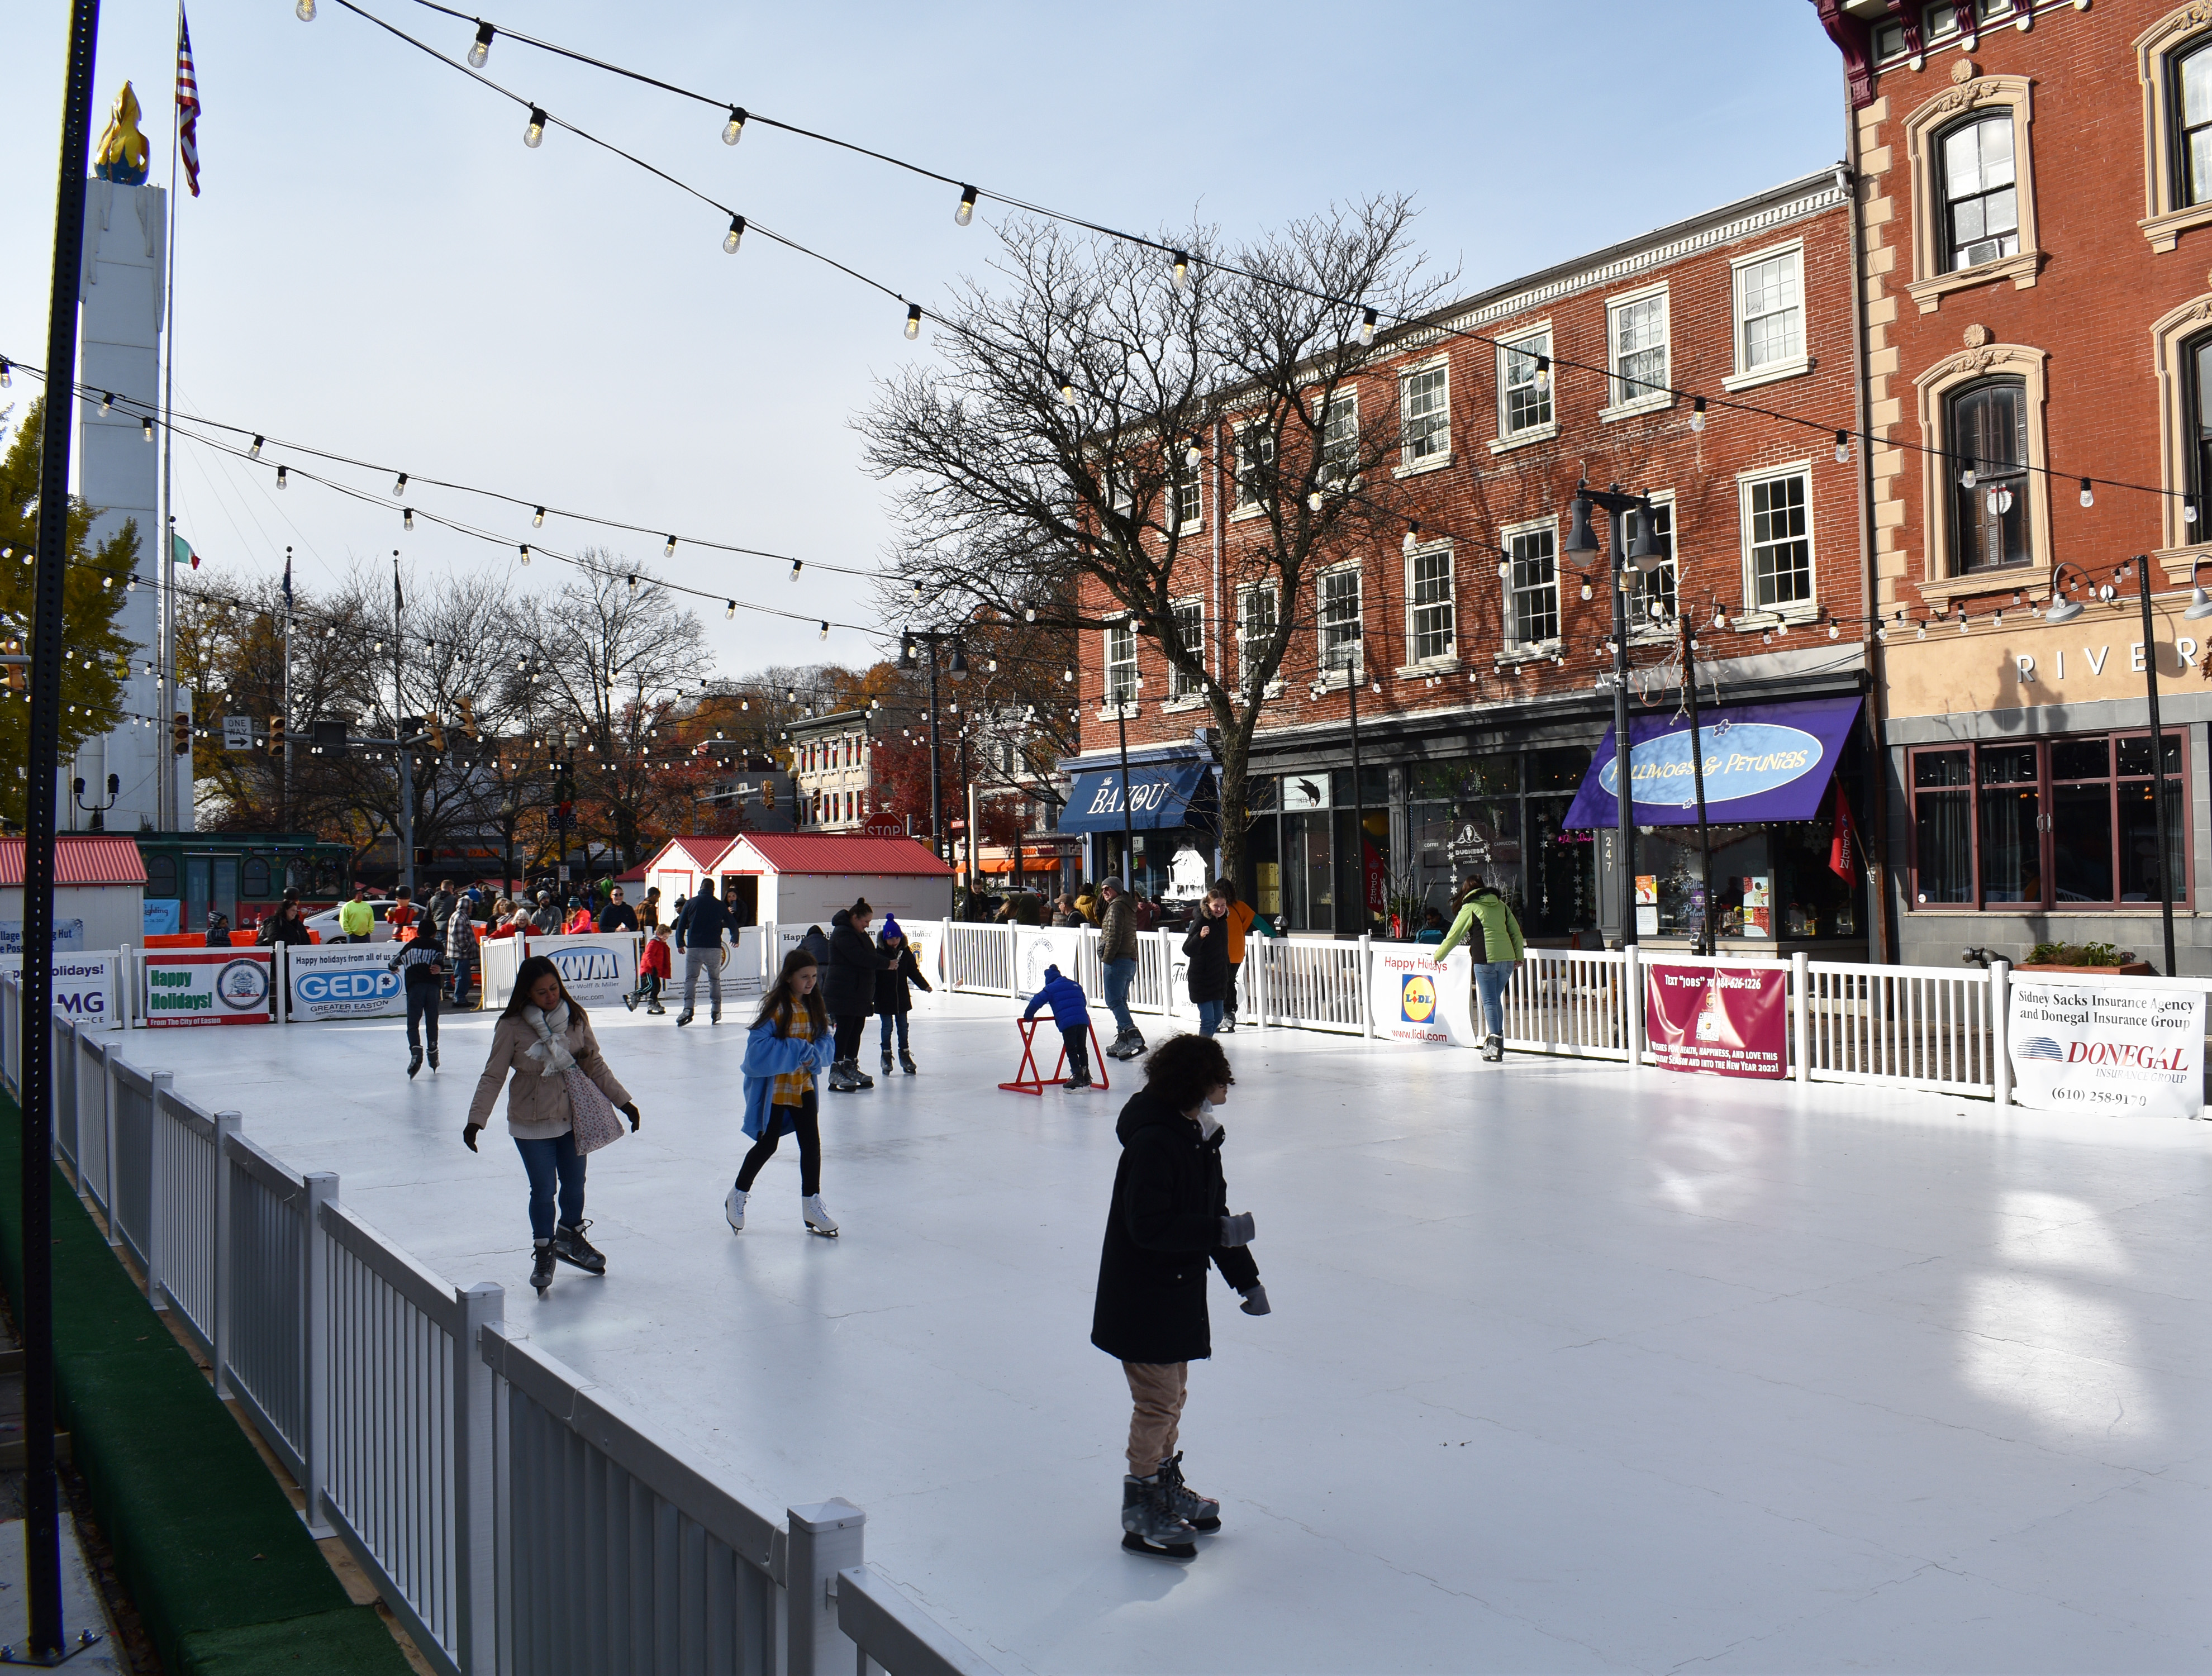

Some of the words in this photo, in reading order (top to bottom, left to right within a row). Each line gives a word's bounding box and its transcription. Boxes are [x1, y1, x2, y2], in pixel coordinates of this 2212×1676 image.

[2016, 637, 2197, 683] RIVER
[1703, 756, 1723, 776] &
[1101, 777, 1112, 786] The
[1087, 783, 1169, 814] BAYOU
[867, 825, 901, 836] STOP
[144, 904, 169, 916] ighting
[59, 929, 72, 939] Hut
[783, 934, 807, 942] Happ
[296, 956, 317, 966] Happy
[320, 955, 346, 965] holidays
[550, 954, 619, 982] KWM
[1385, 956, 1415, 970] Happy
[52, 964, 104, 977] olidays!
[151, 970, 192, 988] Happy
[300, 973, 397, 999] GEDP
[1716, 978, 1761, 989] 484-626-1226
[58, 992, 104, 1013] MG
[151, 992, 212, 1010] Holidays!
[310, 1003, 351, 1012] GREATER
[354, 1001, 389, 1010] EASTON
[2019, 991, 2050, 1007] Sidney
[2053, 994, 2087, 1006] Sacks
[2092, 994, 2147, 1008] Insurance
[2150, 998, 2195, 1014] Agency
[2020, 1008, 2039, 1020] and
[2041, 1010, 2089, 1026] Donegal
[2094, 1012, 2147, 1026] Insurance
[2151, 1015, 2190, 1032] Group
[1391, 1029, 1447, 1042] www.lidl.com
[1668, 1044, 1680, 1053] FOR
[1699, 1048, 1731, 1059] HAPPINESS,
[1745, 1051, 1761, 1060] LOVE
[1762, 1052, 1778, 1061] THIS
[2066, 1041, 2189, 1071] DONEGAL
[1688, 1058, 1700, 1066] AND
[1715, 1060, 1726, 1069] THE
[1758, 1063, 1779, 1073] 2022!
[2096, 1068, 2148, 1082] INSURANCE
[2151, 1073, 2187, 1083] GROUP
[2052, 1087, 2085, 1102] (610)
[2090, 1091, 2147, 1106] 258-9170
